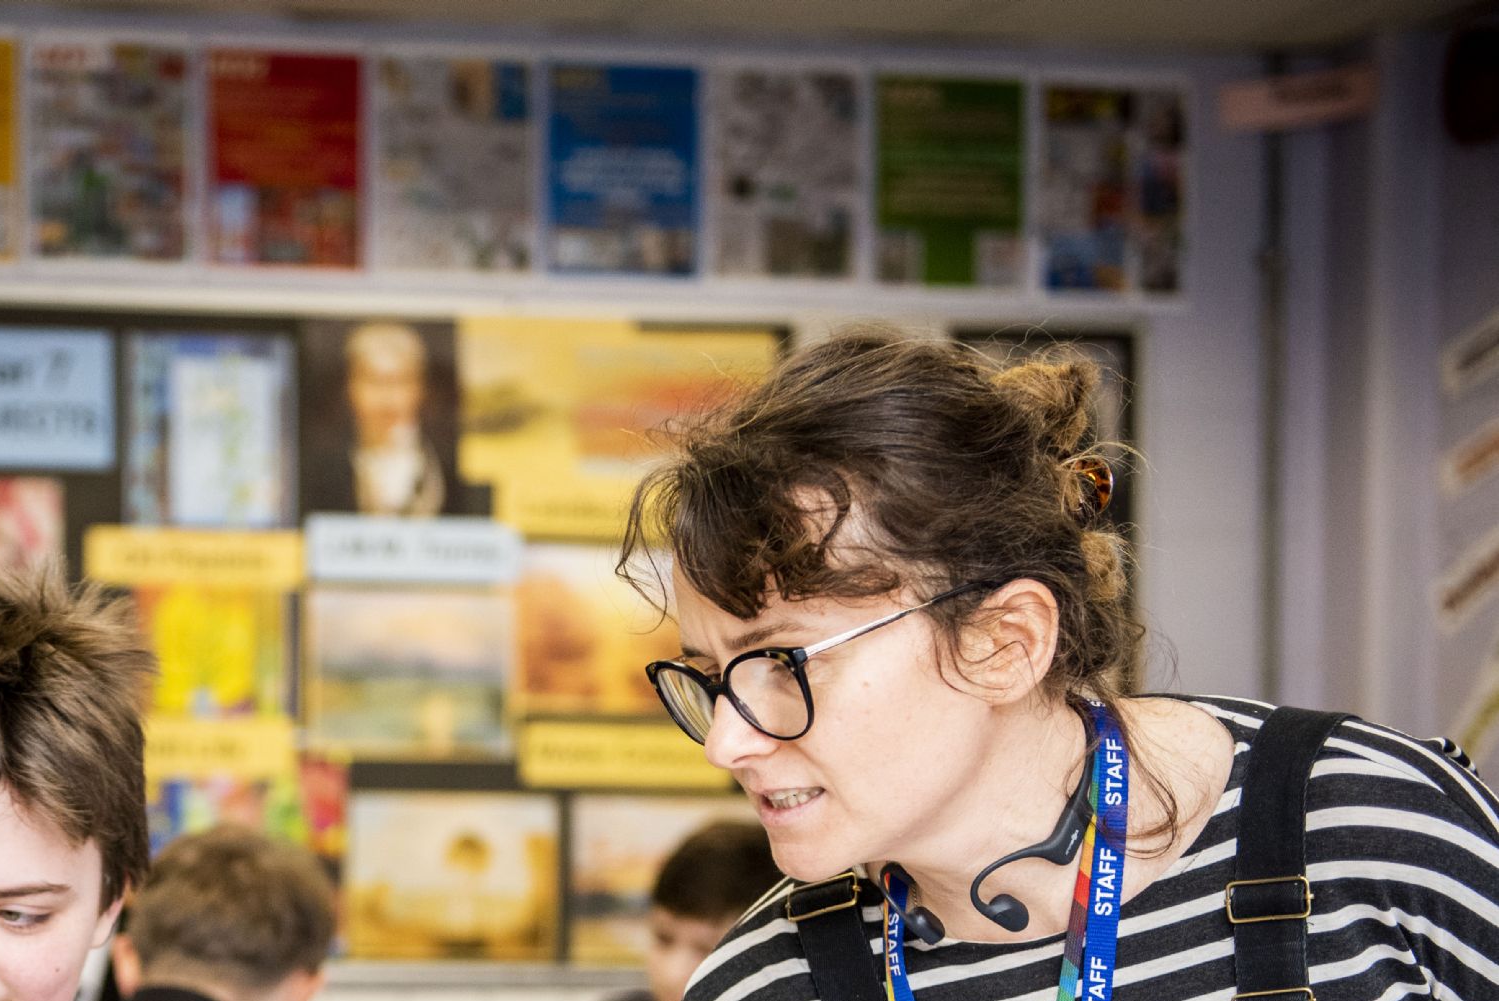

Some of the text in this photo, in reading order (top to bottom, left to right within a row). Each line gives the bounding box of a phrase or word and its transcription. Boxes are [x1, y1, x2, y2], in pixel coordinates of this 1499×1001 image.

[47, 349, 74, 385] 7
[1104, 738, 1124, 806] STAFF
[1094, 848, 1119, 917] STAFF
[887, 911, 902, 978] STAFF
